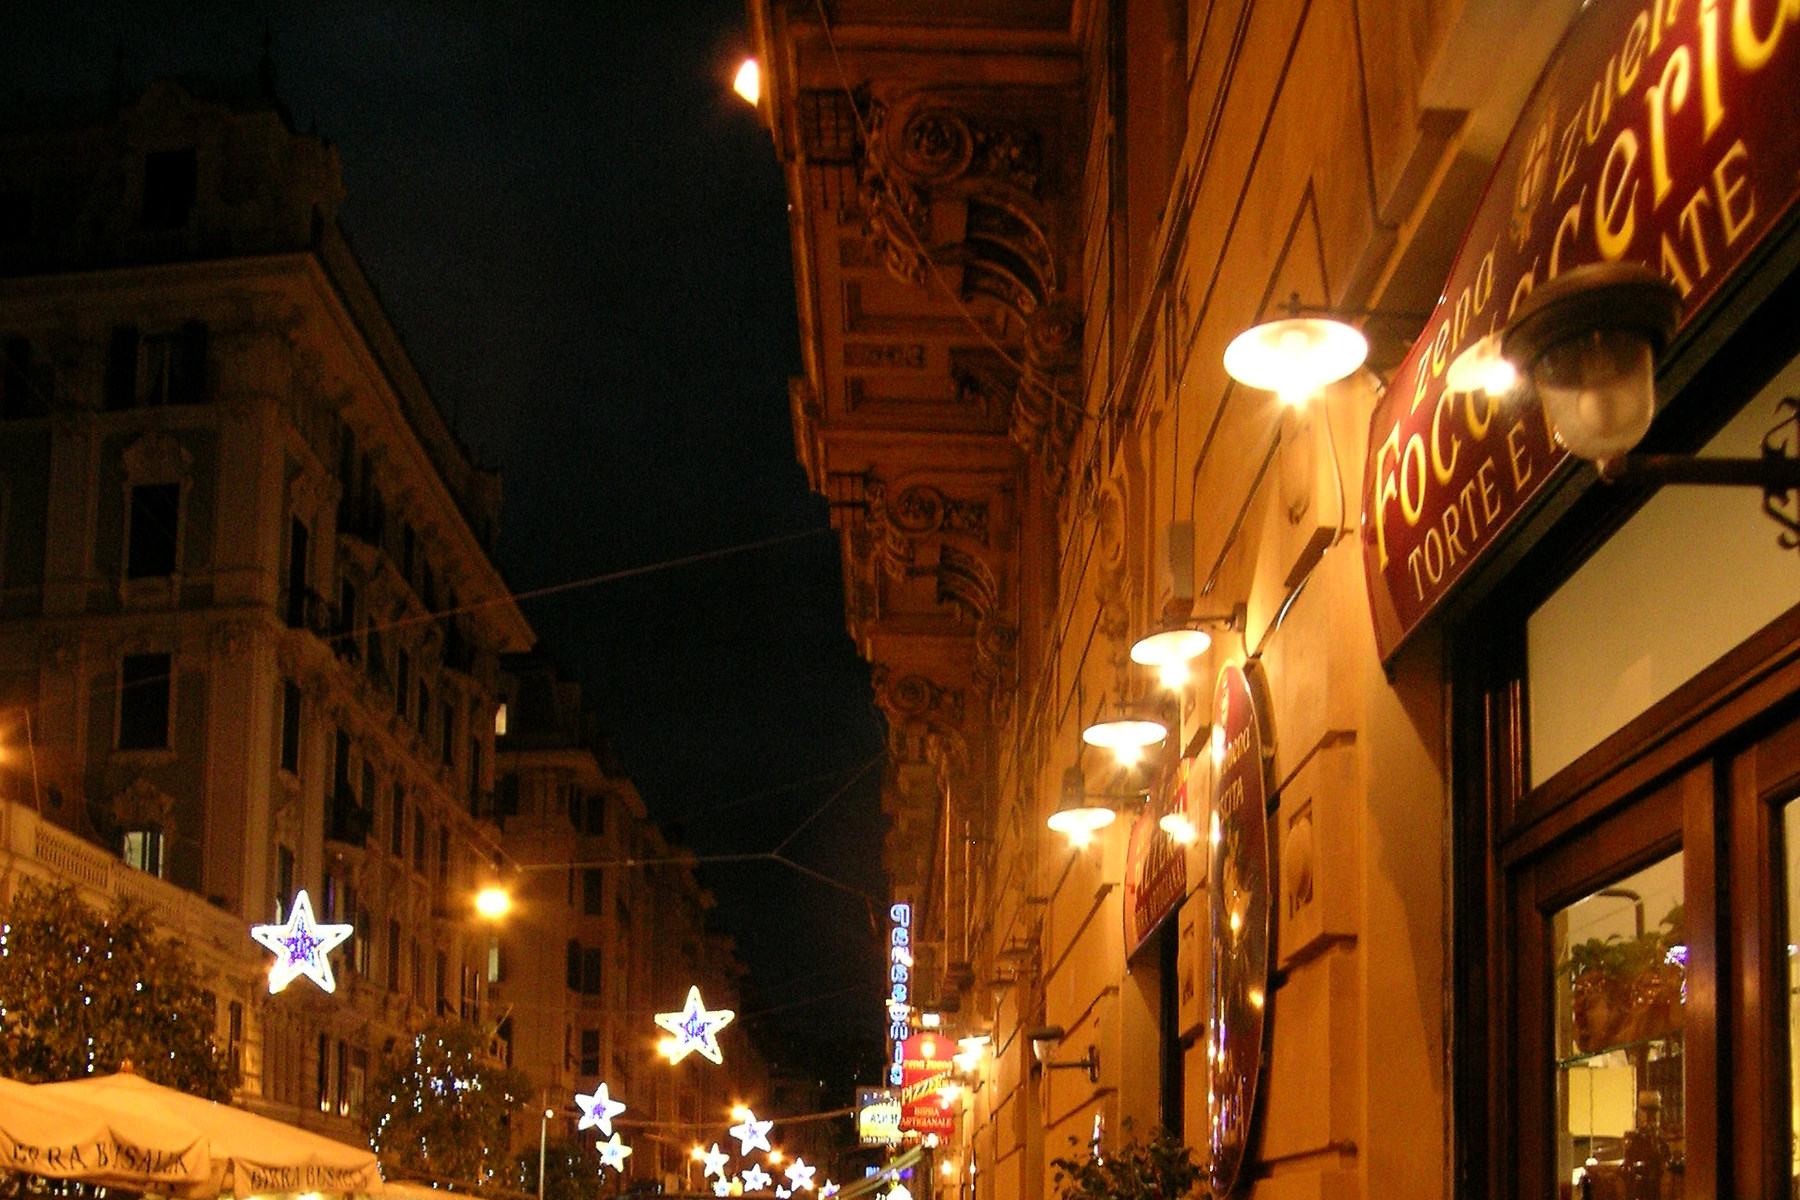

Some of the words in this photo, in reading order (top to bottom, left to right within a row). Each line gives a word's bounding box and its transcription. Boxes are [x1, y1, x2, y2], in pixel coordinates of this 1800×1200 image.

[1410, 232, 1500, 415] zena
[1408, 456, 1501, 601] TORTE
[1506, 420, 1534, 492] E
